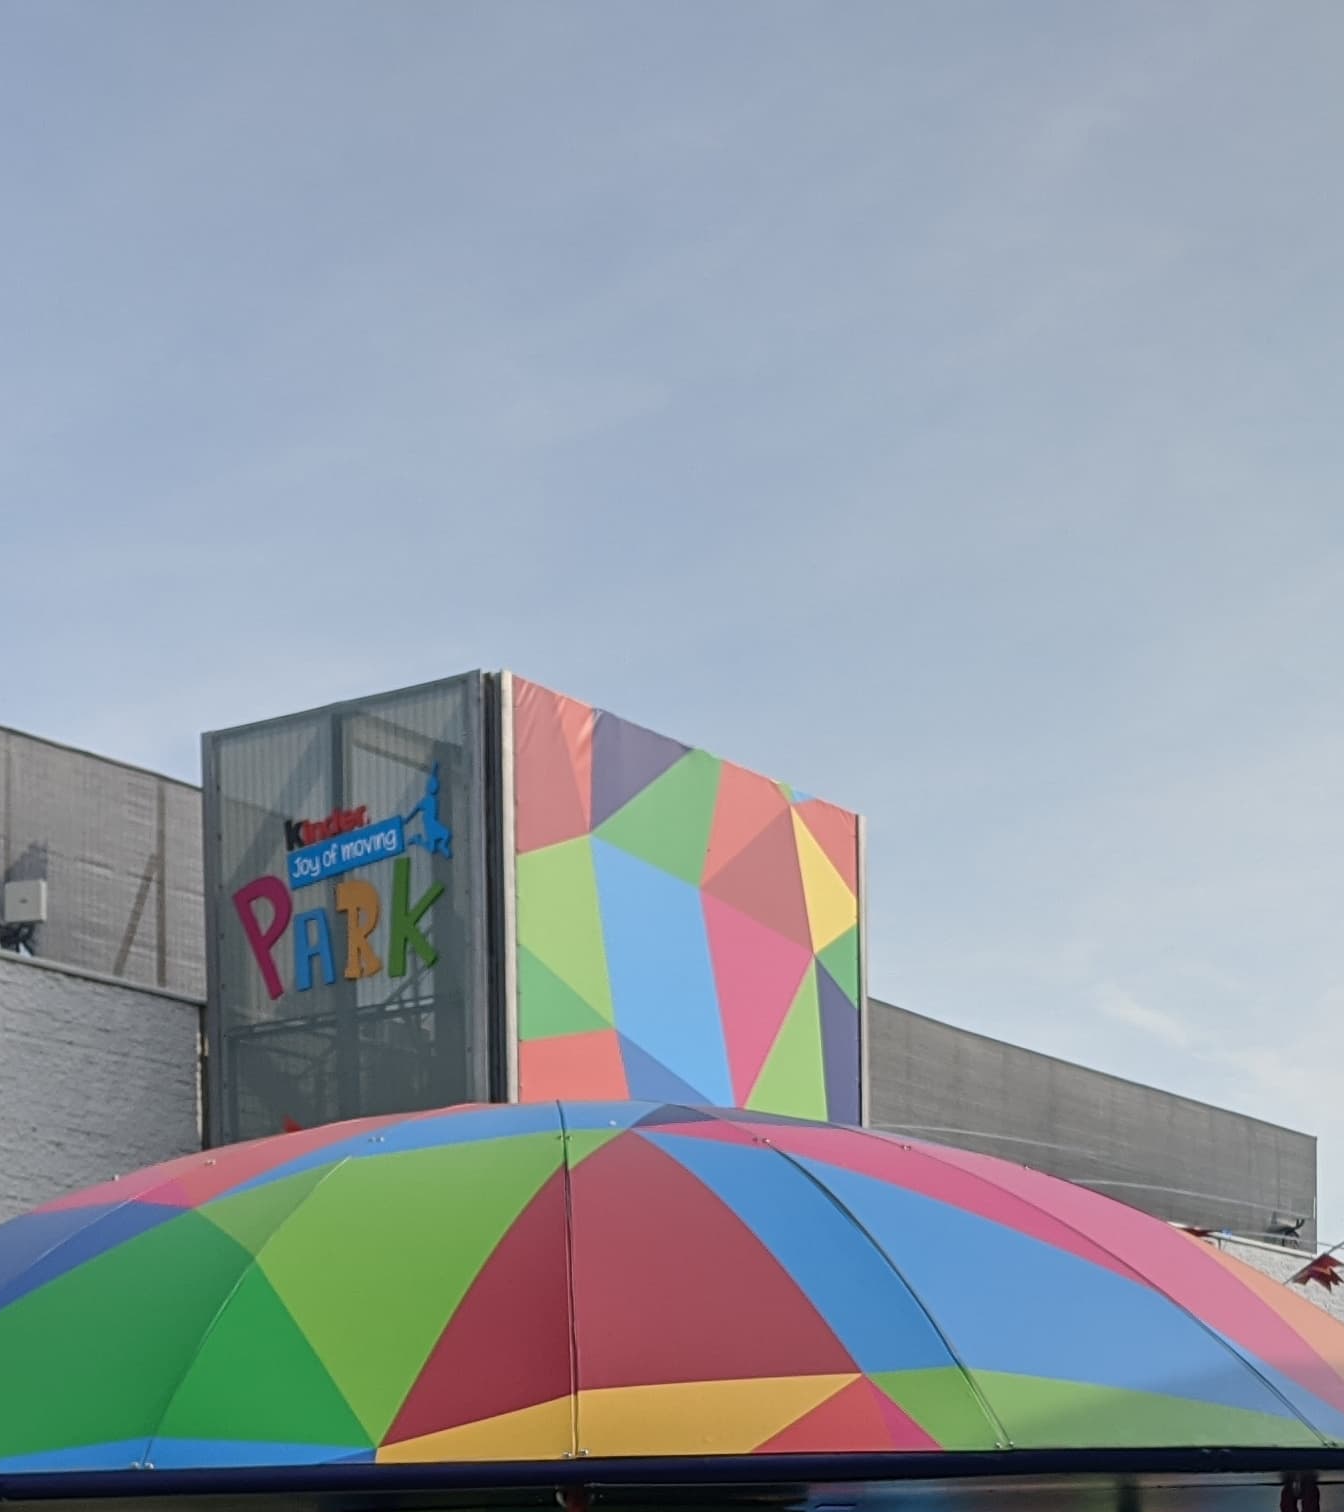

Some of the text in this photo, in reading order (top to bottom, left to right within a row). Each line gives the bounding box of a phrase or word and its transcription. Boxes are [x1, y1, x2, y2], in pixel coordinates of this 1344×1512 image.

[292, 829, 397, 878] Joy of moving
[232, 857, 446, 1001] PARK
